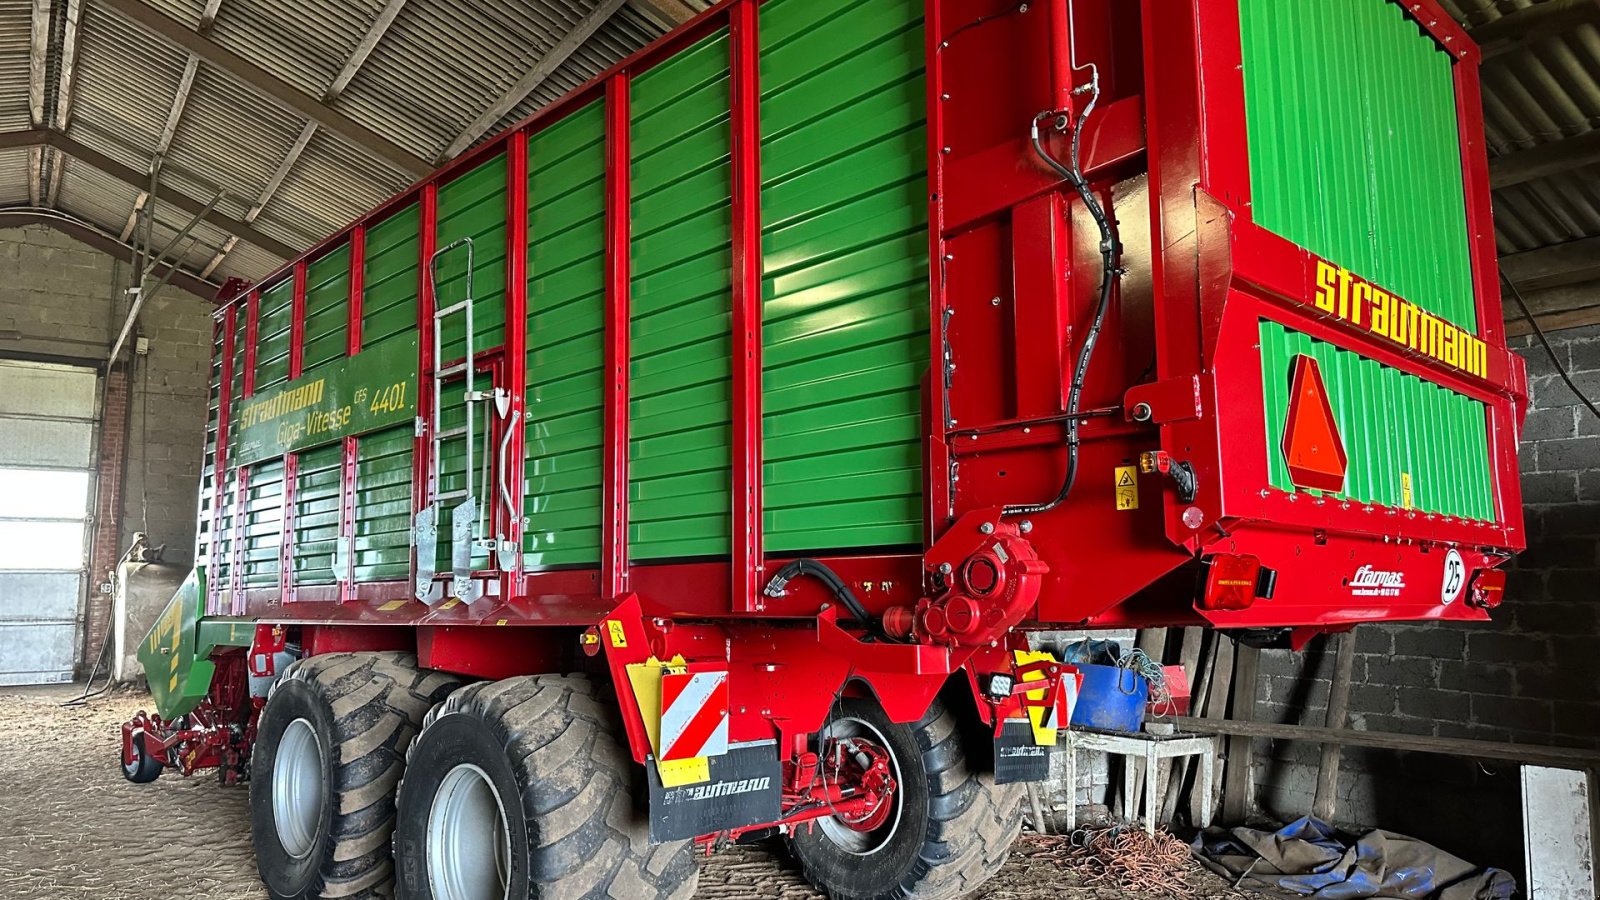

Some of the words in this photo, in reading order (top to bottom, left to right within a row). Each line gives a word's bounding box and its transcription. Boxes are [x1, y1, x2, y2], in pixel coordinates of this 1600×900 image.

[1315, 260, 1487, 380] strautmann
[239, 379, 325, 431] strautmann
[276, 405, 352, 447] Giga-Vitesse
[370, 381, 406, 416] 4401
[1445, 560, 1460, 594] 25
